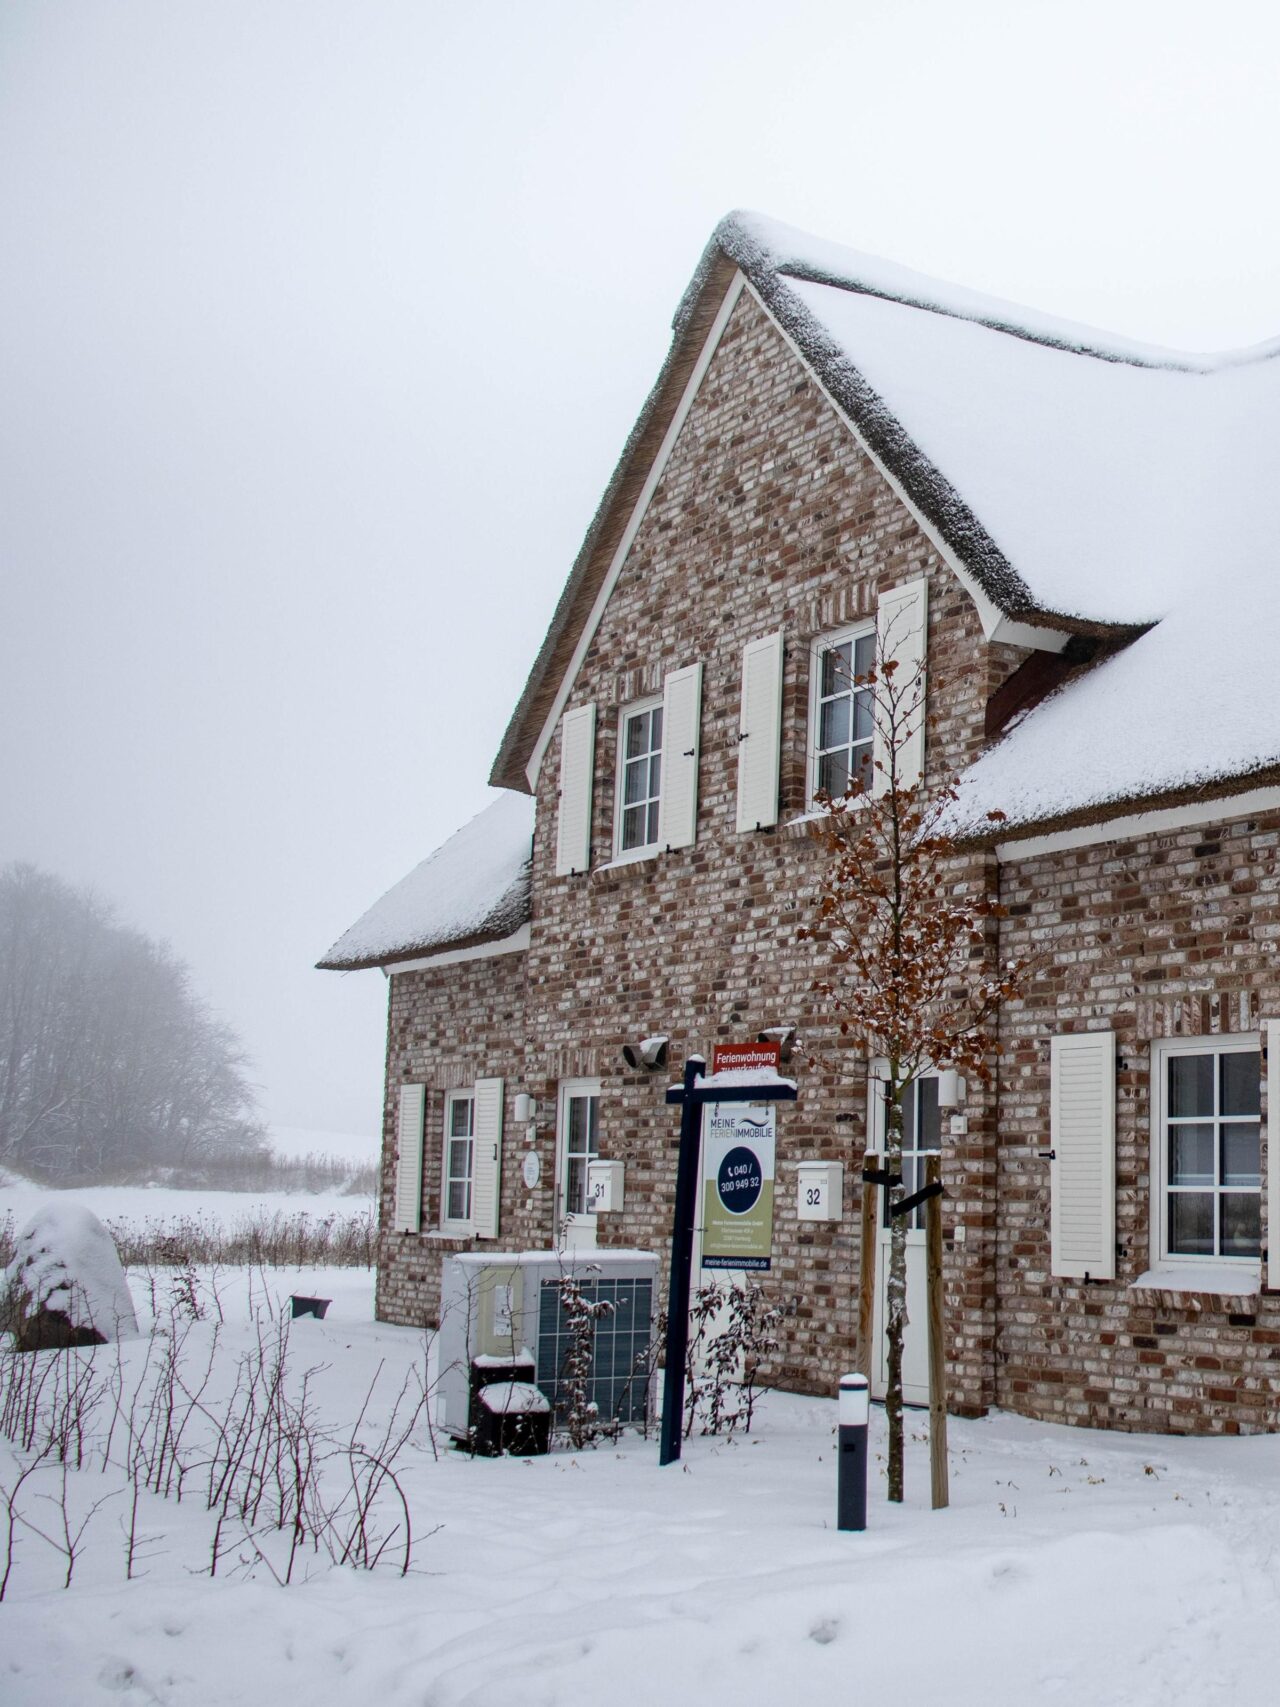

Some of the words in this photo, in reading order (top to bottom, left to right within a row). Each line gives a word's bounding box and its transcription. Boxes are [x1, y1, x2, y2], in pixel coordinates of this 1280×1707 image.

[716, 1050, 777, 1064] Ferienwohnung
[710, 1118, 736, 1129] MEINE
[710, 1127, 773, 1139] FERIENIMMOBILIE
[733, 1164, 748, 1176] 040
[594, 1183, 605, 1198] 31
[720, 1180, 735, 1192] 300
[735, 1178, 749, 1190] 949
[750, 1176, 760, 1188] 32
[806, 1188, 821, 1206] 32
